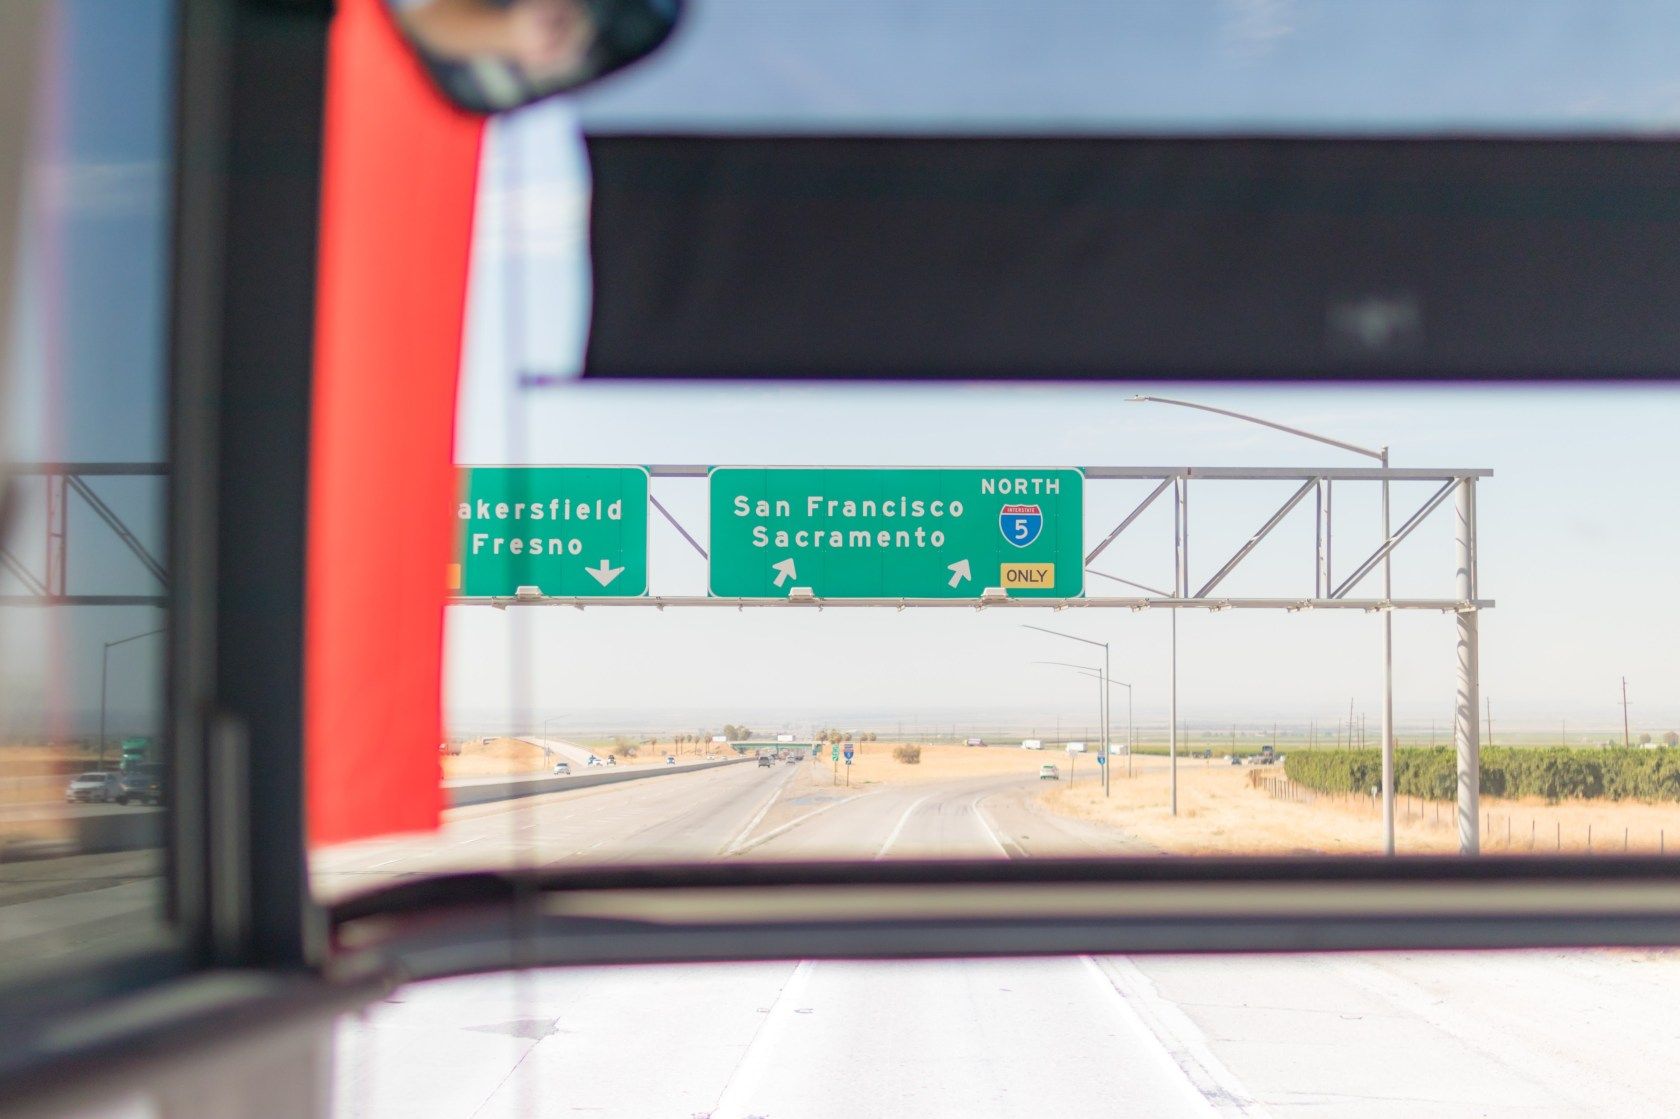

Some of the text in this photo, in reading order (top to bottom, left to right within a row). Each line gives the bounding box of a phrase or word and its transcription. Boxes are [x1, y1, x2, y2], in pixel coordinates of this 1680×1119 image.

[981, 478, 1060, 495] NORTH
[457, 498, 622, 520] akersfield
[733, 495, 964, 518] San Francisco
[752, 525, 946, 548] Sacramento
[1014, 518, 1029, 540] 5
[472, 533, 584, 555] Fresno
[1006, 569, 1048, 583] ONLY
